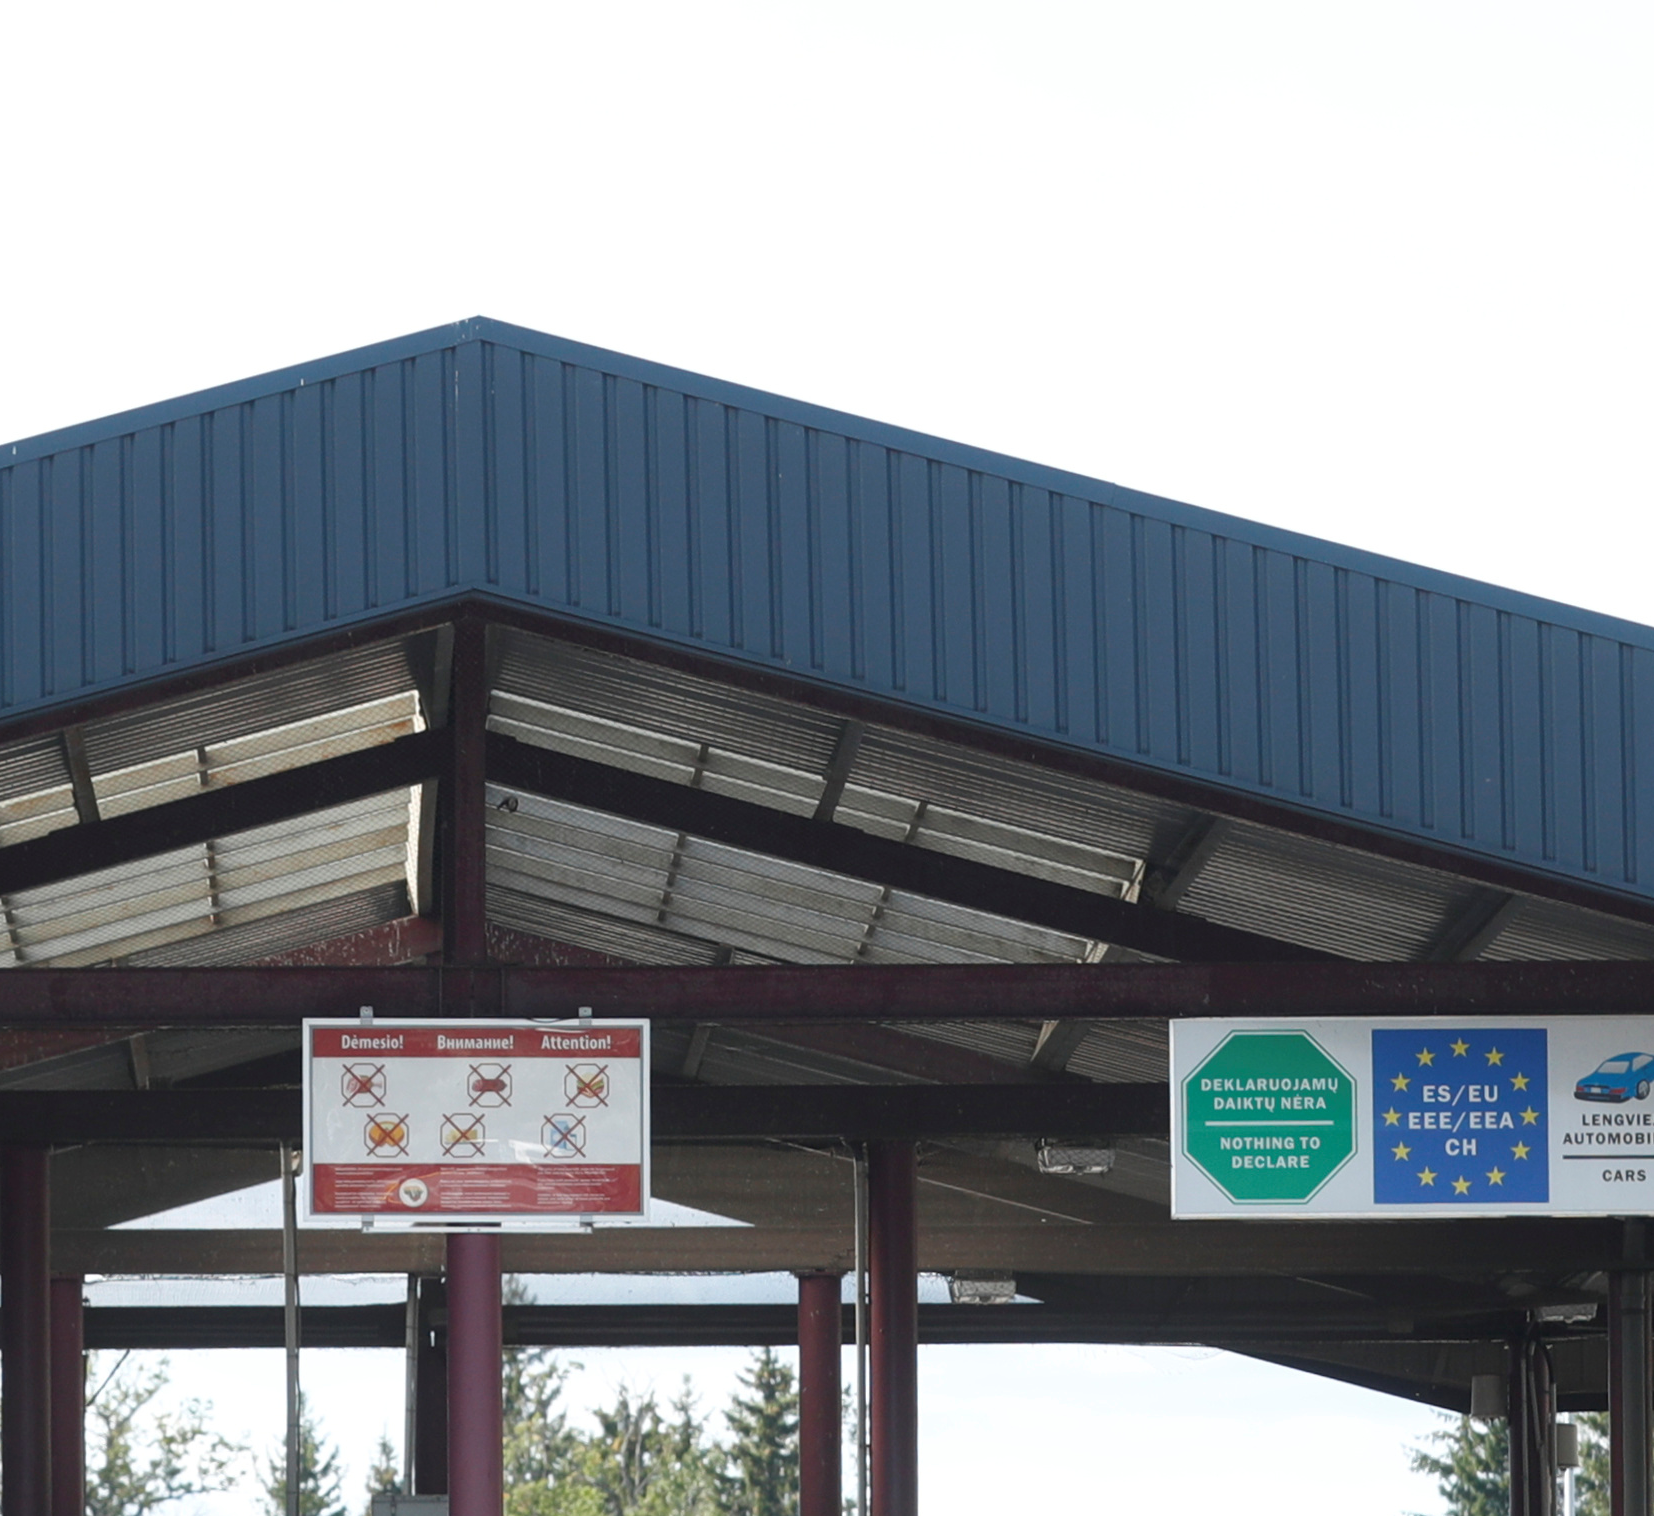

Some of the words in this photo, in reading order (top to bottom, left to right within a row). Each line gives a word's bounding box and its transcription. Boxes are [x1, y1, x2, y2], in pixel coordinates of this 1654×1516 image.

[342, 1035, 403, 1049] Dėmesio!
[438, 1035, 513, 1049] Внимание!
[542, 1035, 610, 1050] Attention!
[1201, 1078, 1338, 1095] DEKLARUOJAMŲ
[1423, 1085, 1497, 1105] ES/EU
[1214, 1097, 1275, 1112] DAIKTŲ
[1281, 1095, 1326, 1109] NĖRA
[1409, 1112, 1513, 1132] EEE/EEA
[1221, 1137, 1294, 1149] NOTHING
[1300, 1137, 1320, 1149] TO
[1446, 1139, 1476, 1155] CH
[1232, 1156, 1309, 1168] DECLARE
[1603, 1170, 1646, 1181] CARS
